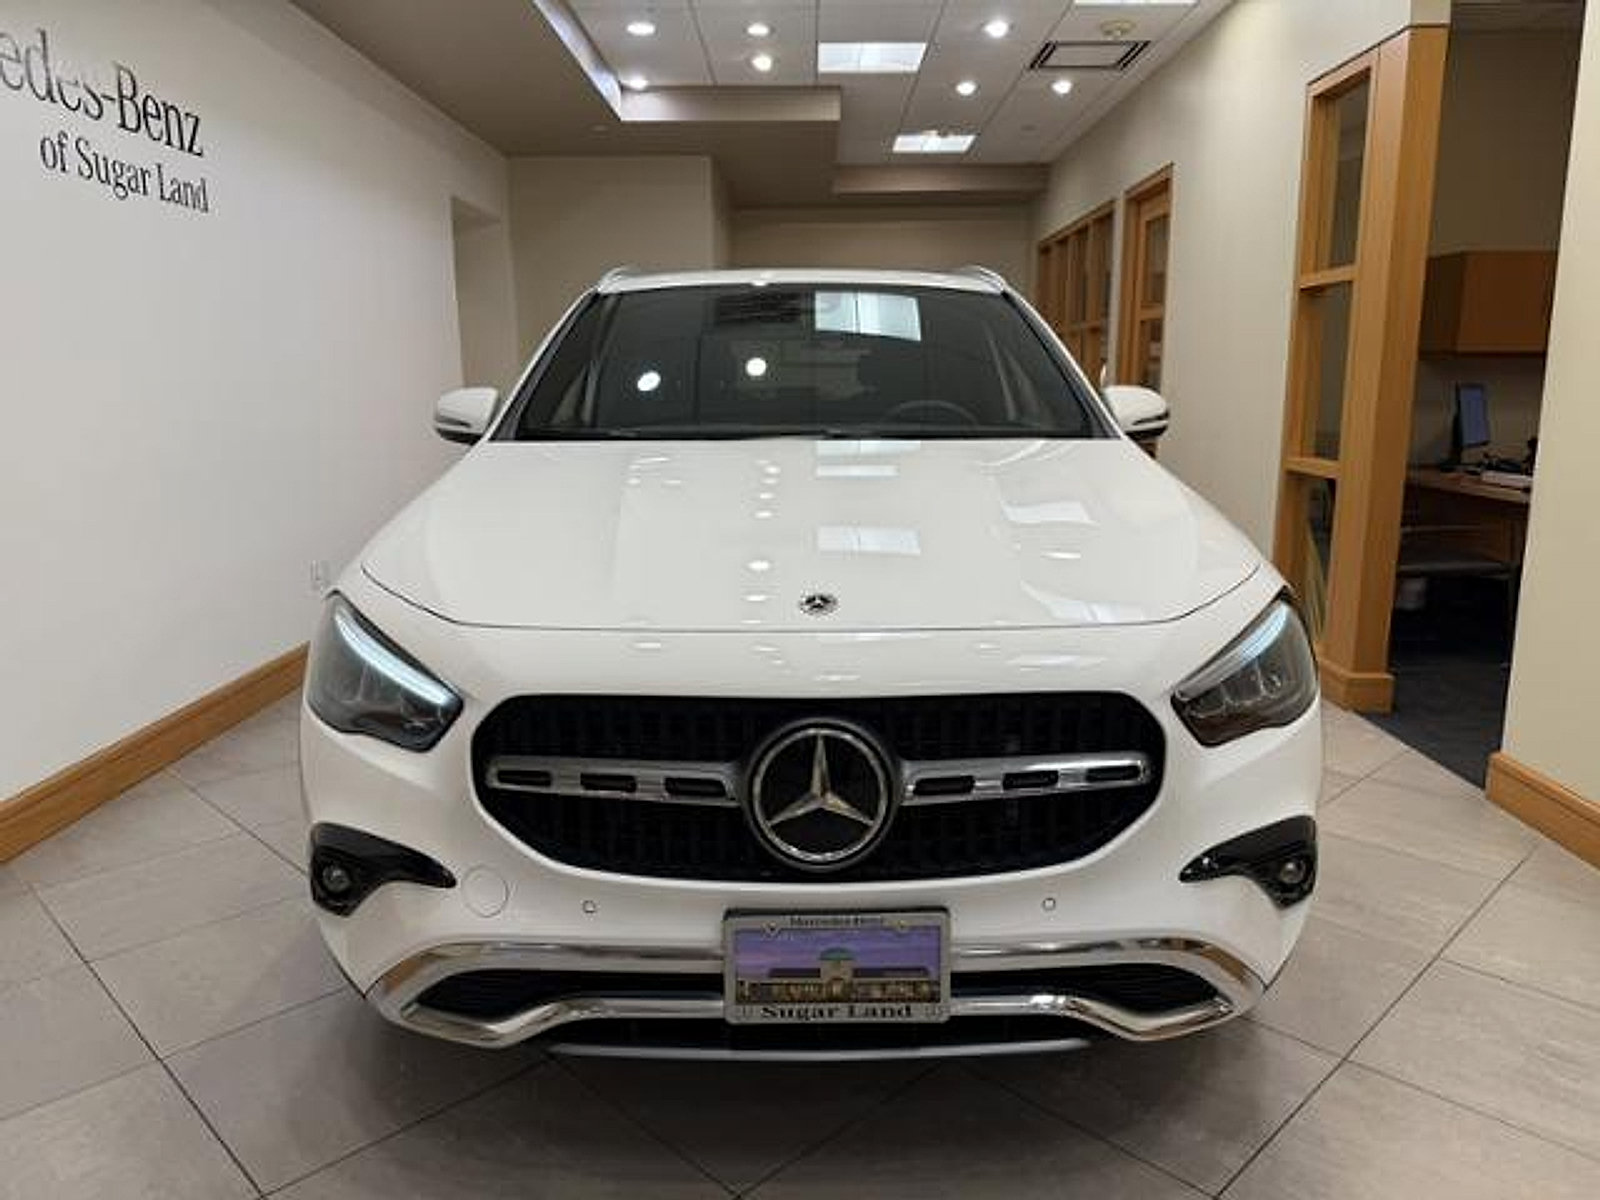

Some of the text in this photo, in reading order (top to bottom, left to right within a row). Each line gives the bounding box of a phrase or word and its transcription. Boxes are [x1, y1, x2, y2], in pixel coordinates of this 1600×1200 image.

[40, 130, 209, 213] of Sugar Land
[761, 1005, 912, 1020] Sugar Land
